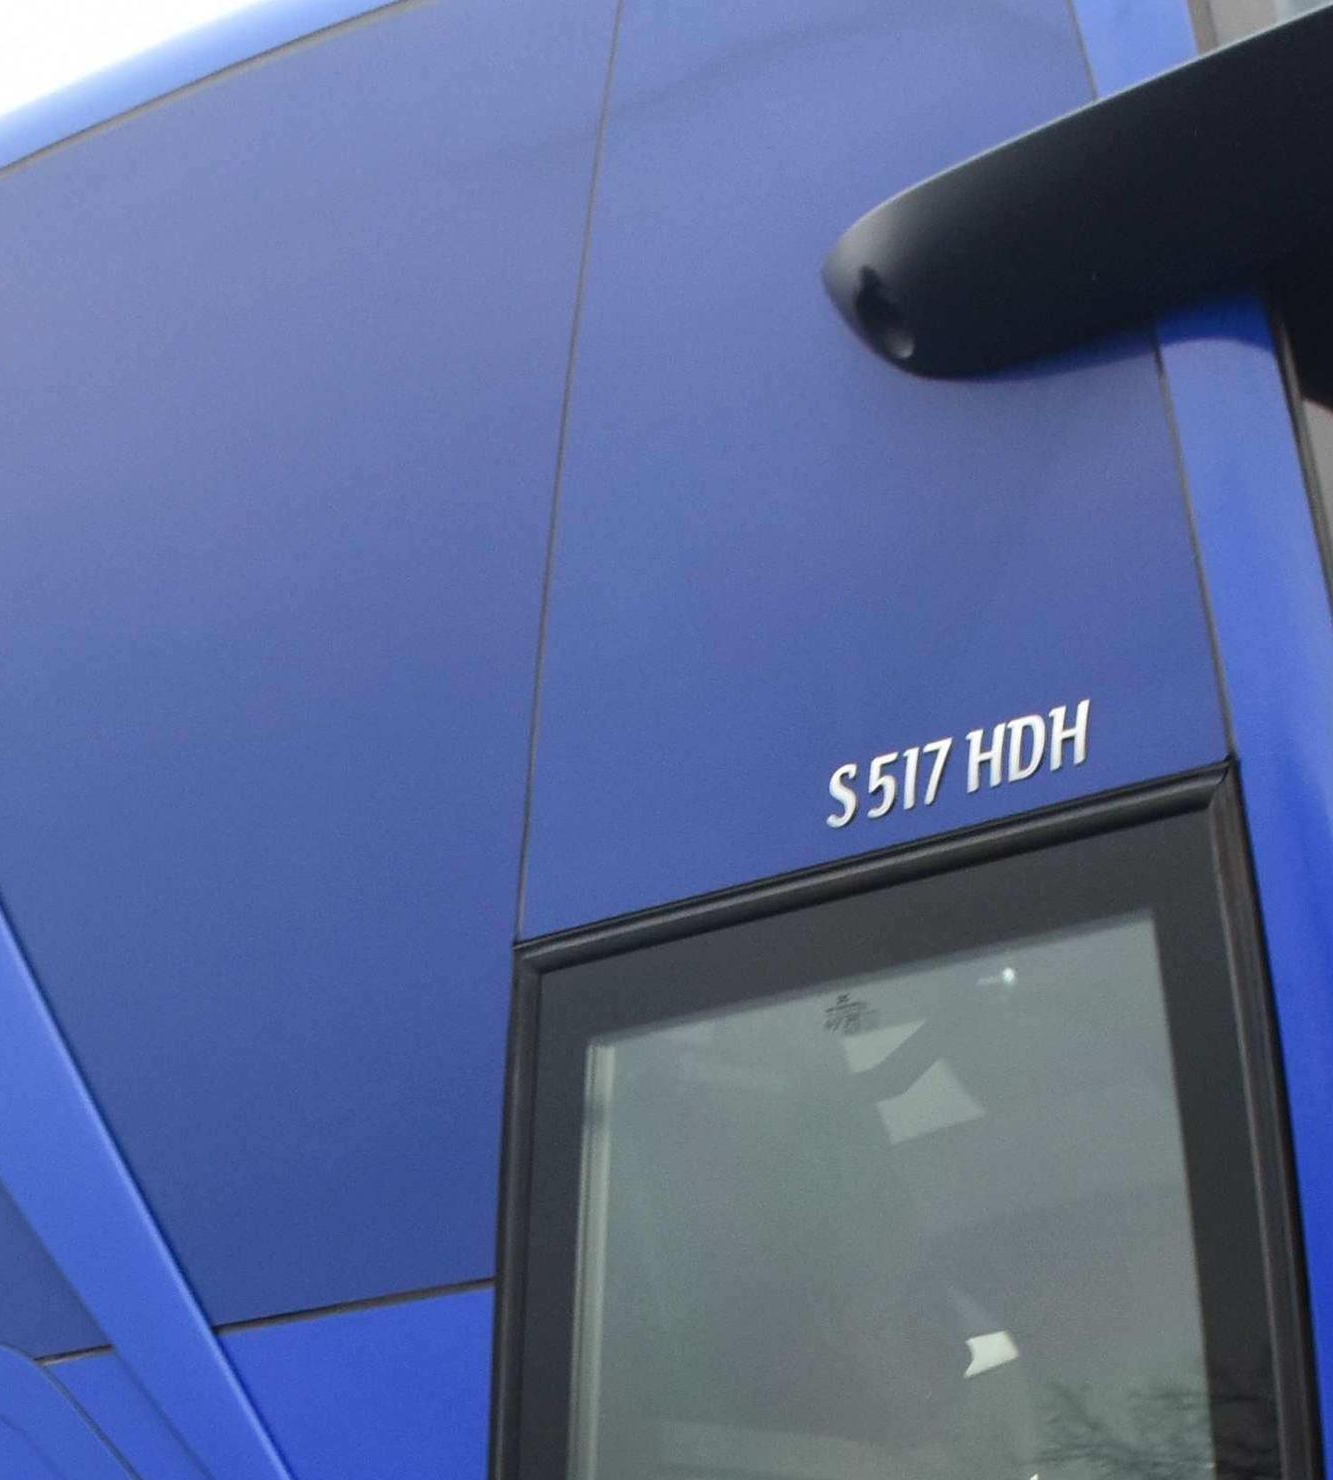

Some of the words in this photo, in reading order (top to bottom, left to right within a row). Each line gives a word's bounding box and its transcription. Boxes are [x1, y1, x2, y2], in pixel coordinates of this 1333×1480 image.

[827, 763, 860, 828] S
[867, 737, 952, 820] 517
[966, 699, 1090, 793] HDH
